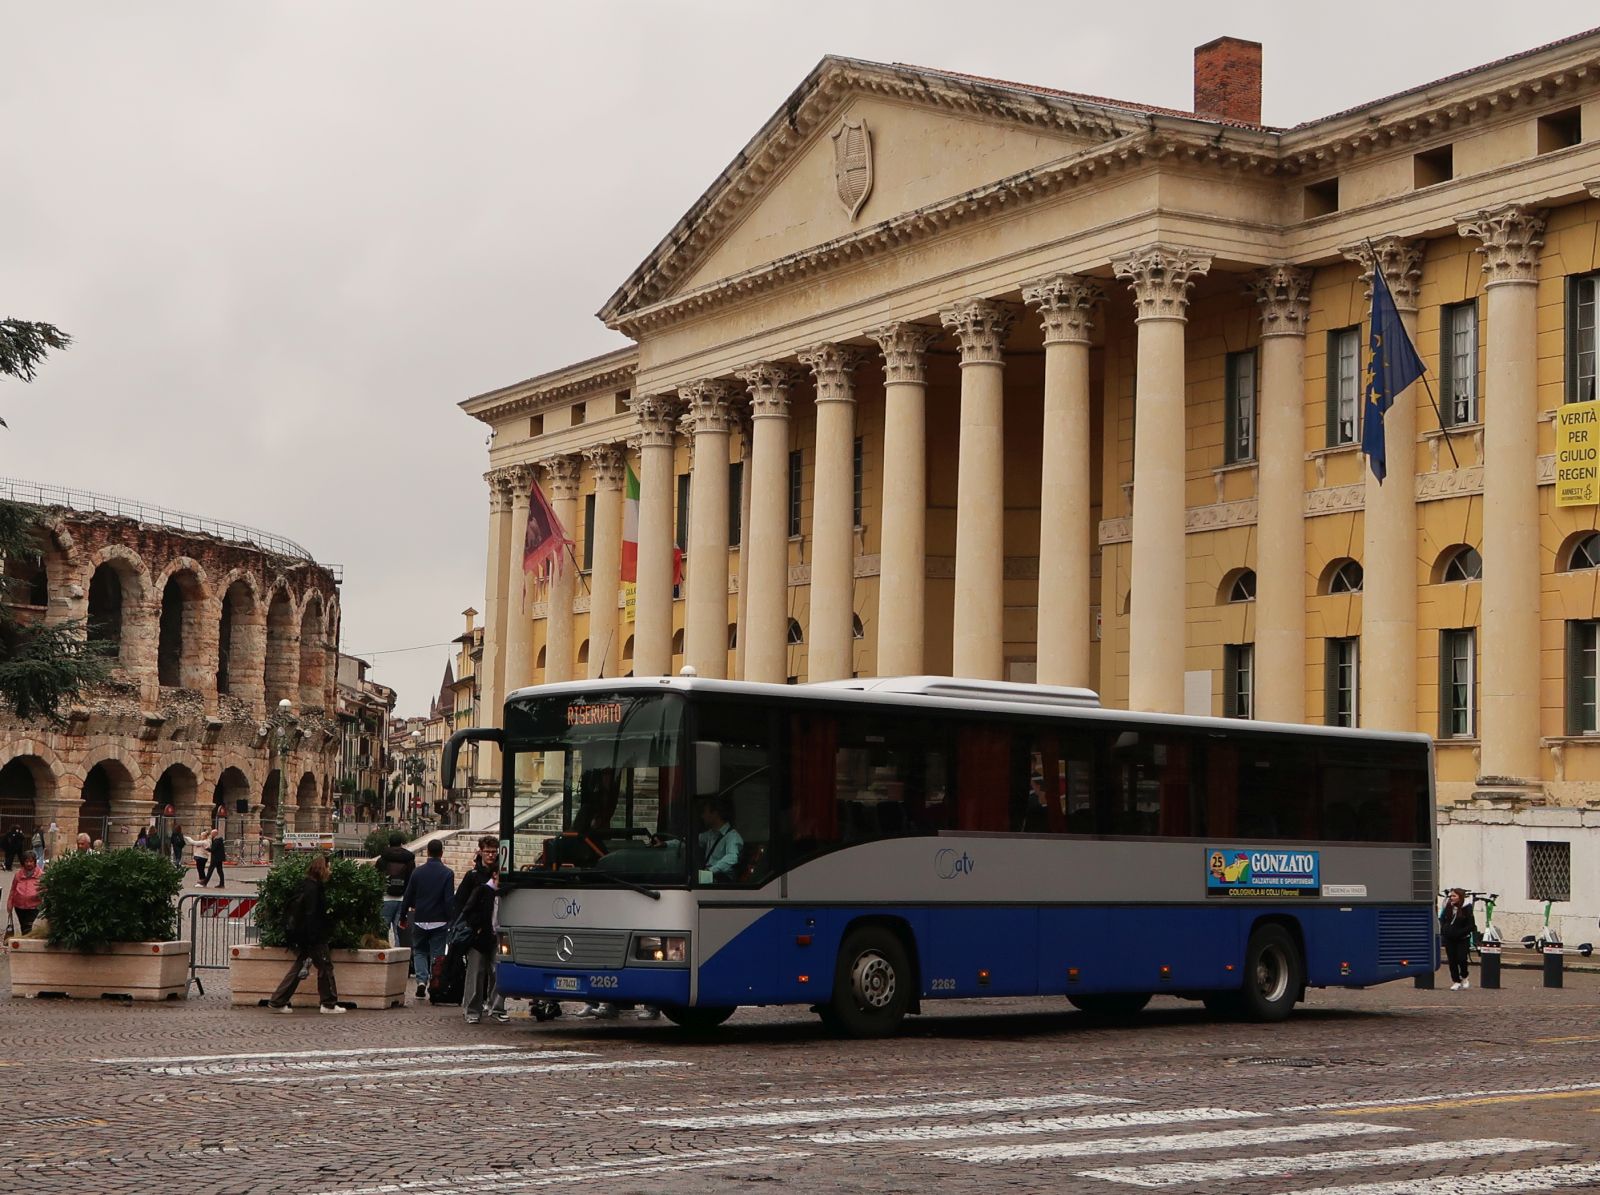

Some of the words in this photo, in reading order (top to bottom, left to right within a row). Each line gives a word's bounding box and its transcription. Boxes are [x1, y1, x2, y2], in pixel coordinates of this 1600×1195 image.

[1561, 408, 1597, 425] VERITÀ
[1568, 430, 1588, 443] PER
[1560, 448, 1597, 463] GIULIO
[1558, 467, 1597, 480] REGENI
[1561, 488, 1583, 496] AMNESTY
[567, 703, 622, 725] RISERVATO
[955, 852, 975, 874] atv
[1212, 856, 1223, 868] 25
[1251, 853, 1314, 873] GONZATO
[566, 899, 581, 916] atv
[589, 975, 619, 988] 2262
[931, 979, 956, 989] 2262
